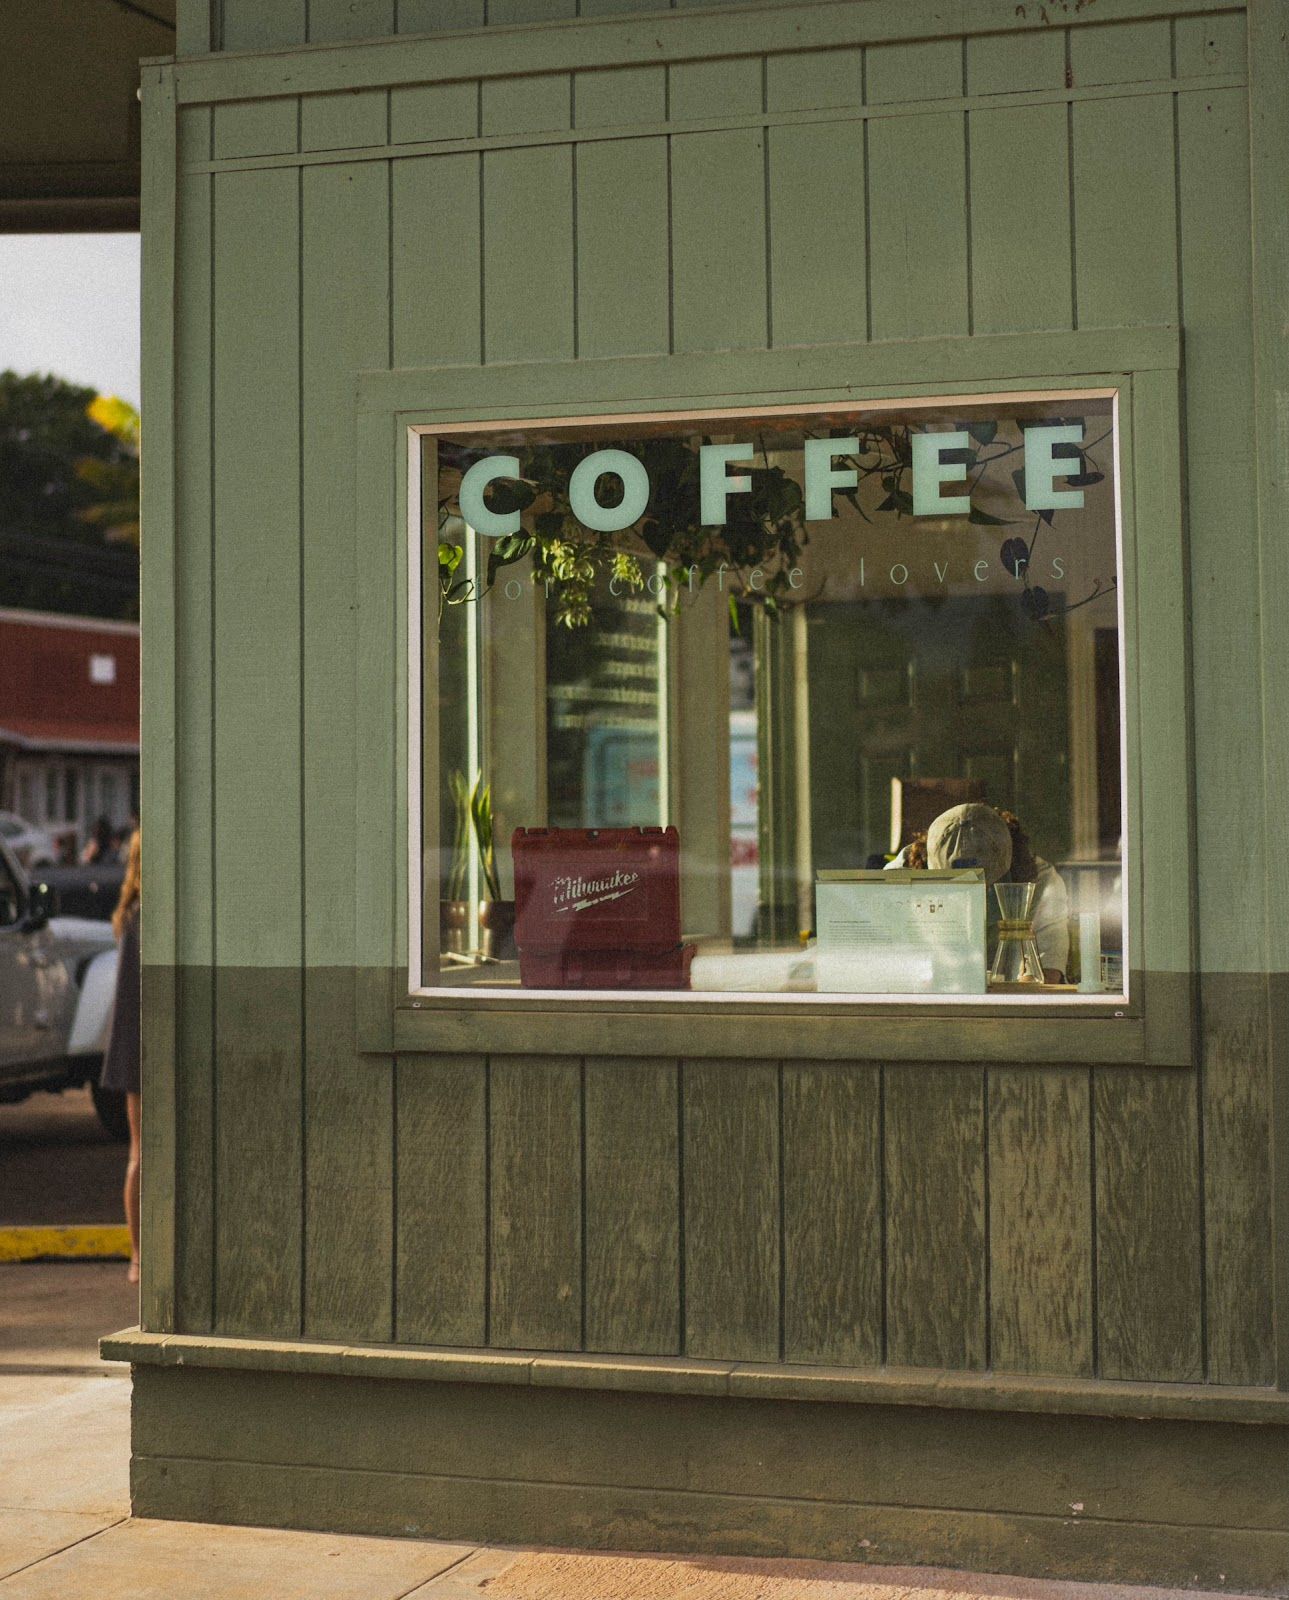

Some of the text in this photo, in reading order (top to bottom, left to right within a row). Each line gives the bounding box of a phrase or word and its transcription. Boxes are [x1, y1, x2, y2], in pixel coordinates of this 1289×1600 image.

[459, 425, 1085, 537] COFFEE
[609, 563, 804, 597] coffee
[860, 556, 1065, 587] lovers
